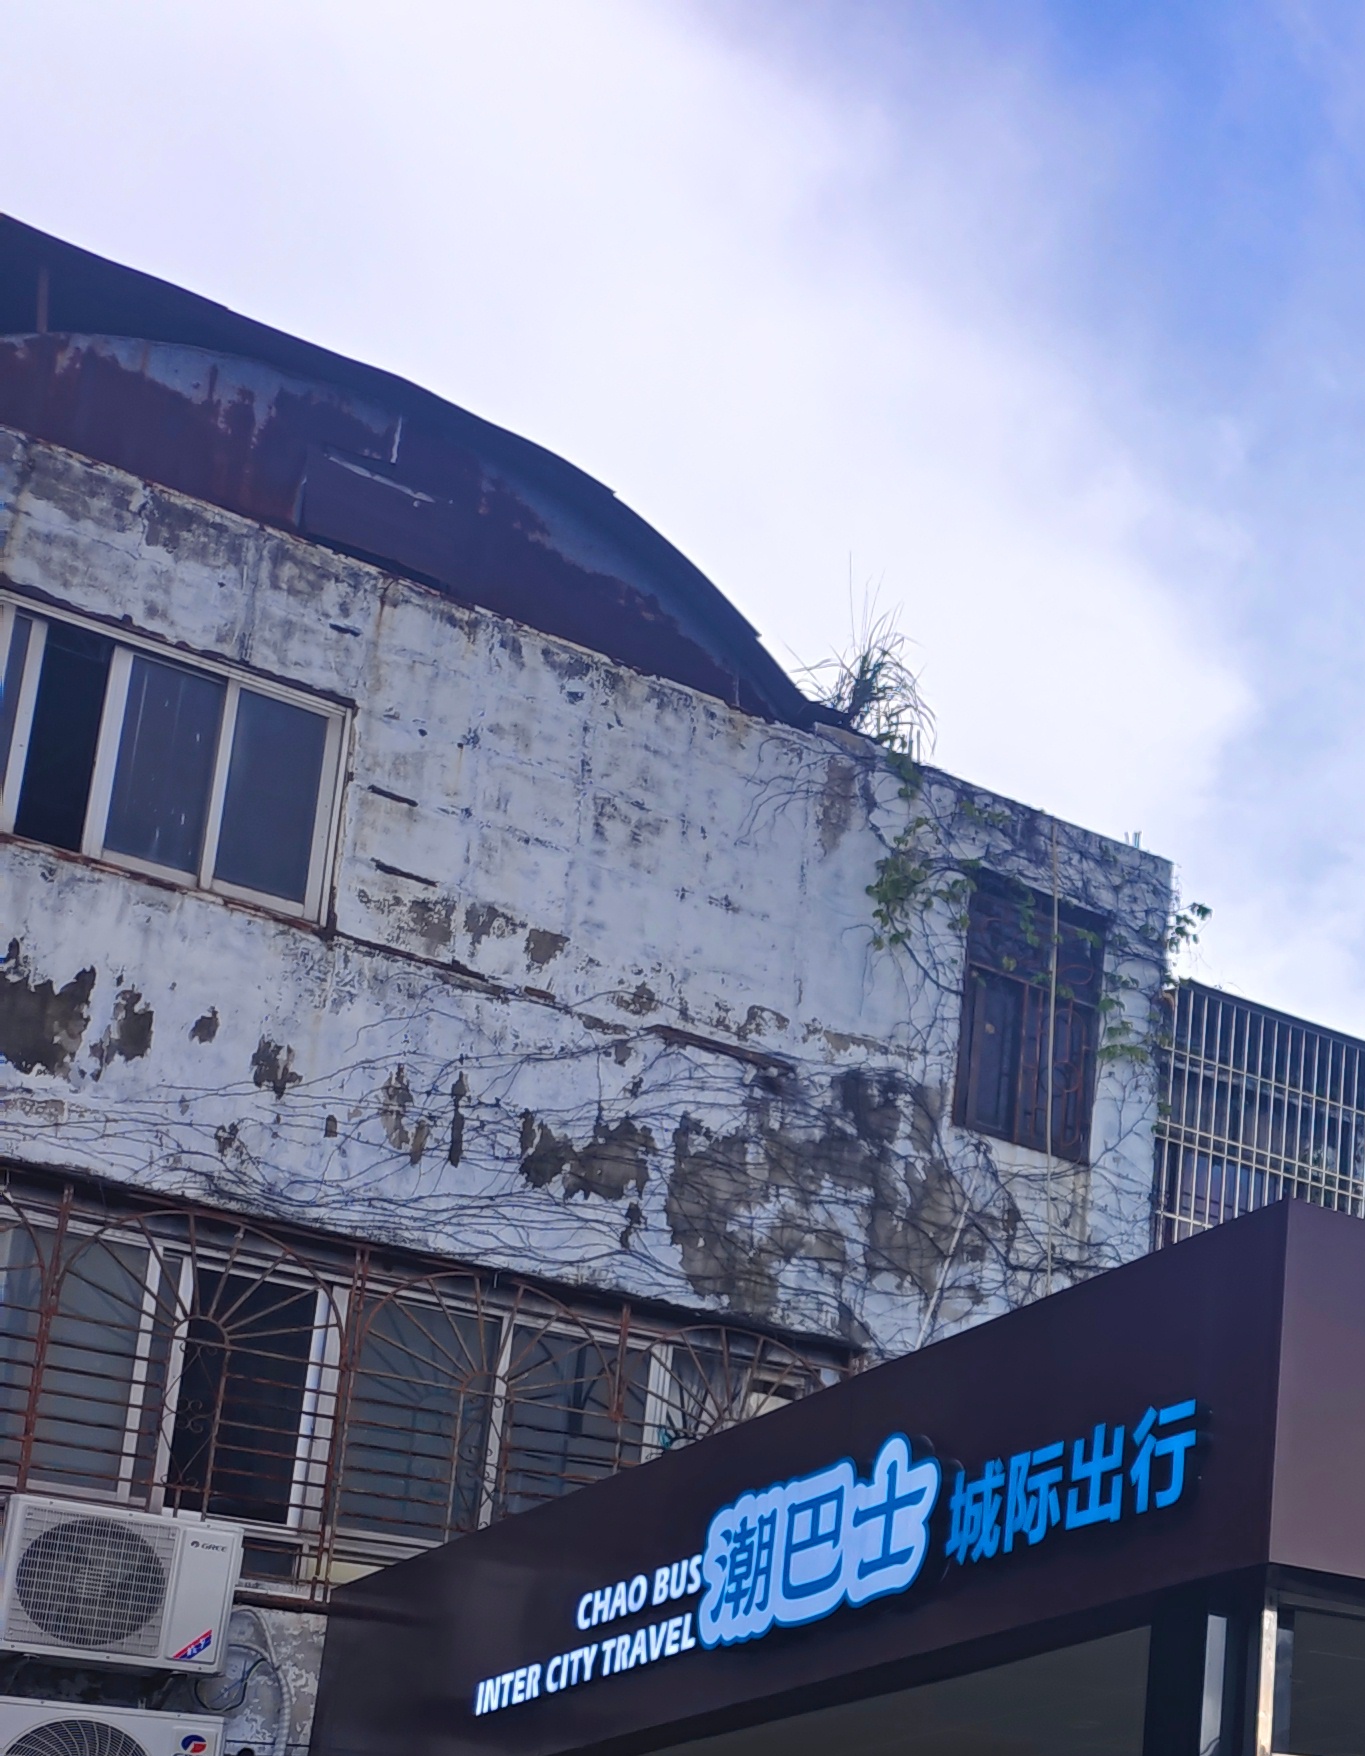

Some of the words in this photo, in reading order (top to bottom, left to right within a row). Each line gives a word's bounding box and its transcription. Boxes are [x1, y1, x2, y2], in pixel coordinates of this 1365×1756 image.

[200, 1542, 228, 1553] GREE
[708, 1454, 930, 1626] 潮巴士
[943, 1399, 1198, 1567] 城际出行
[576, 1574, 648, 1630] CHAO
[652, 1554, 703, 1607] BUS
[475, 1663, 542, 1717] INTER
[545, 1643, 598, 1693] CITY
[602, 1612, 697, 1677] TRAVEL
